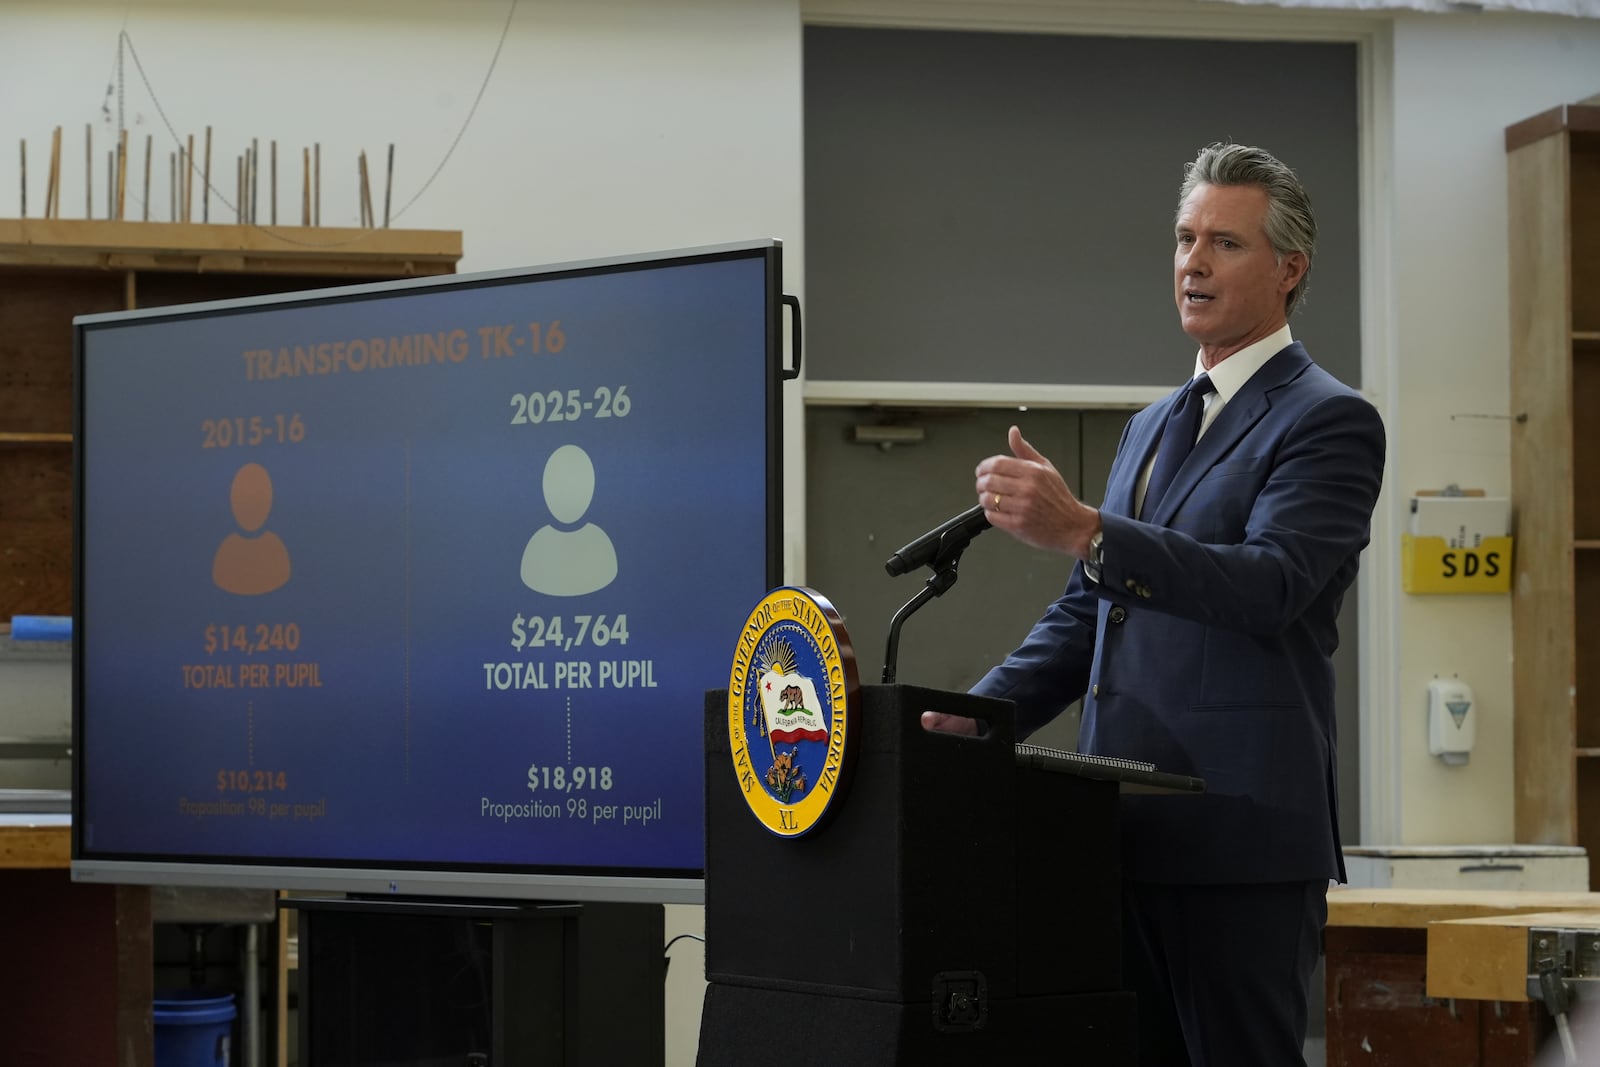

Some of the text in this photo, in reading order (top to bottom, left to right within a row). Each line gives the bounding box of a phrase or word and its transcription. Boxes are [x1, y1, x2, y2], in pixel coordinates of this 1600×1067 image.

[243, 320, 566, 381] TRANSFORMING TK-16
[510, 385, 632, 425] 2025-26
[202, 413, 306, 449] 2015-16
[1441, 552, 1500, 578] SDS
[772, 600, 781, 613] OF
[781, 599, 793, 611] THE
[793, 596, 824, 639] STATE
[204, 622, 300, 655] $14,240
[510, 613, 630, 652] $24,764
[732, 603, 774, 697] GOVERNOR
[821, 633, 837, 663] OF
[182, 663, 323, 689] TOTAL PER PUPIL
[483, 660, 658, 690] TOTAL PER PUPIL
[775, 716, 797, 727] CALIFORNIA
[820, 666, 844, 793] CALIFORNIA
[216, 768, 288, 793] $10,214
[527, 763, 613, 792] $18,918
[735, 740, 756, 793] SEAL
[294, 797, 327, 823] pupil
[481, 797, 661, 826] Proposition 98 per pupil
[779, 808, 798, 830] XL
